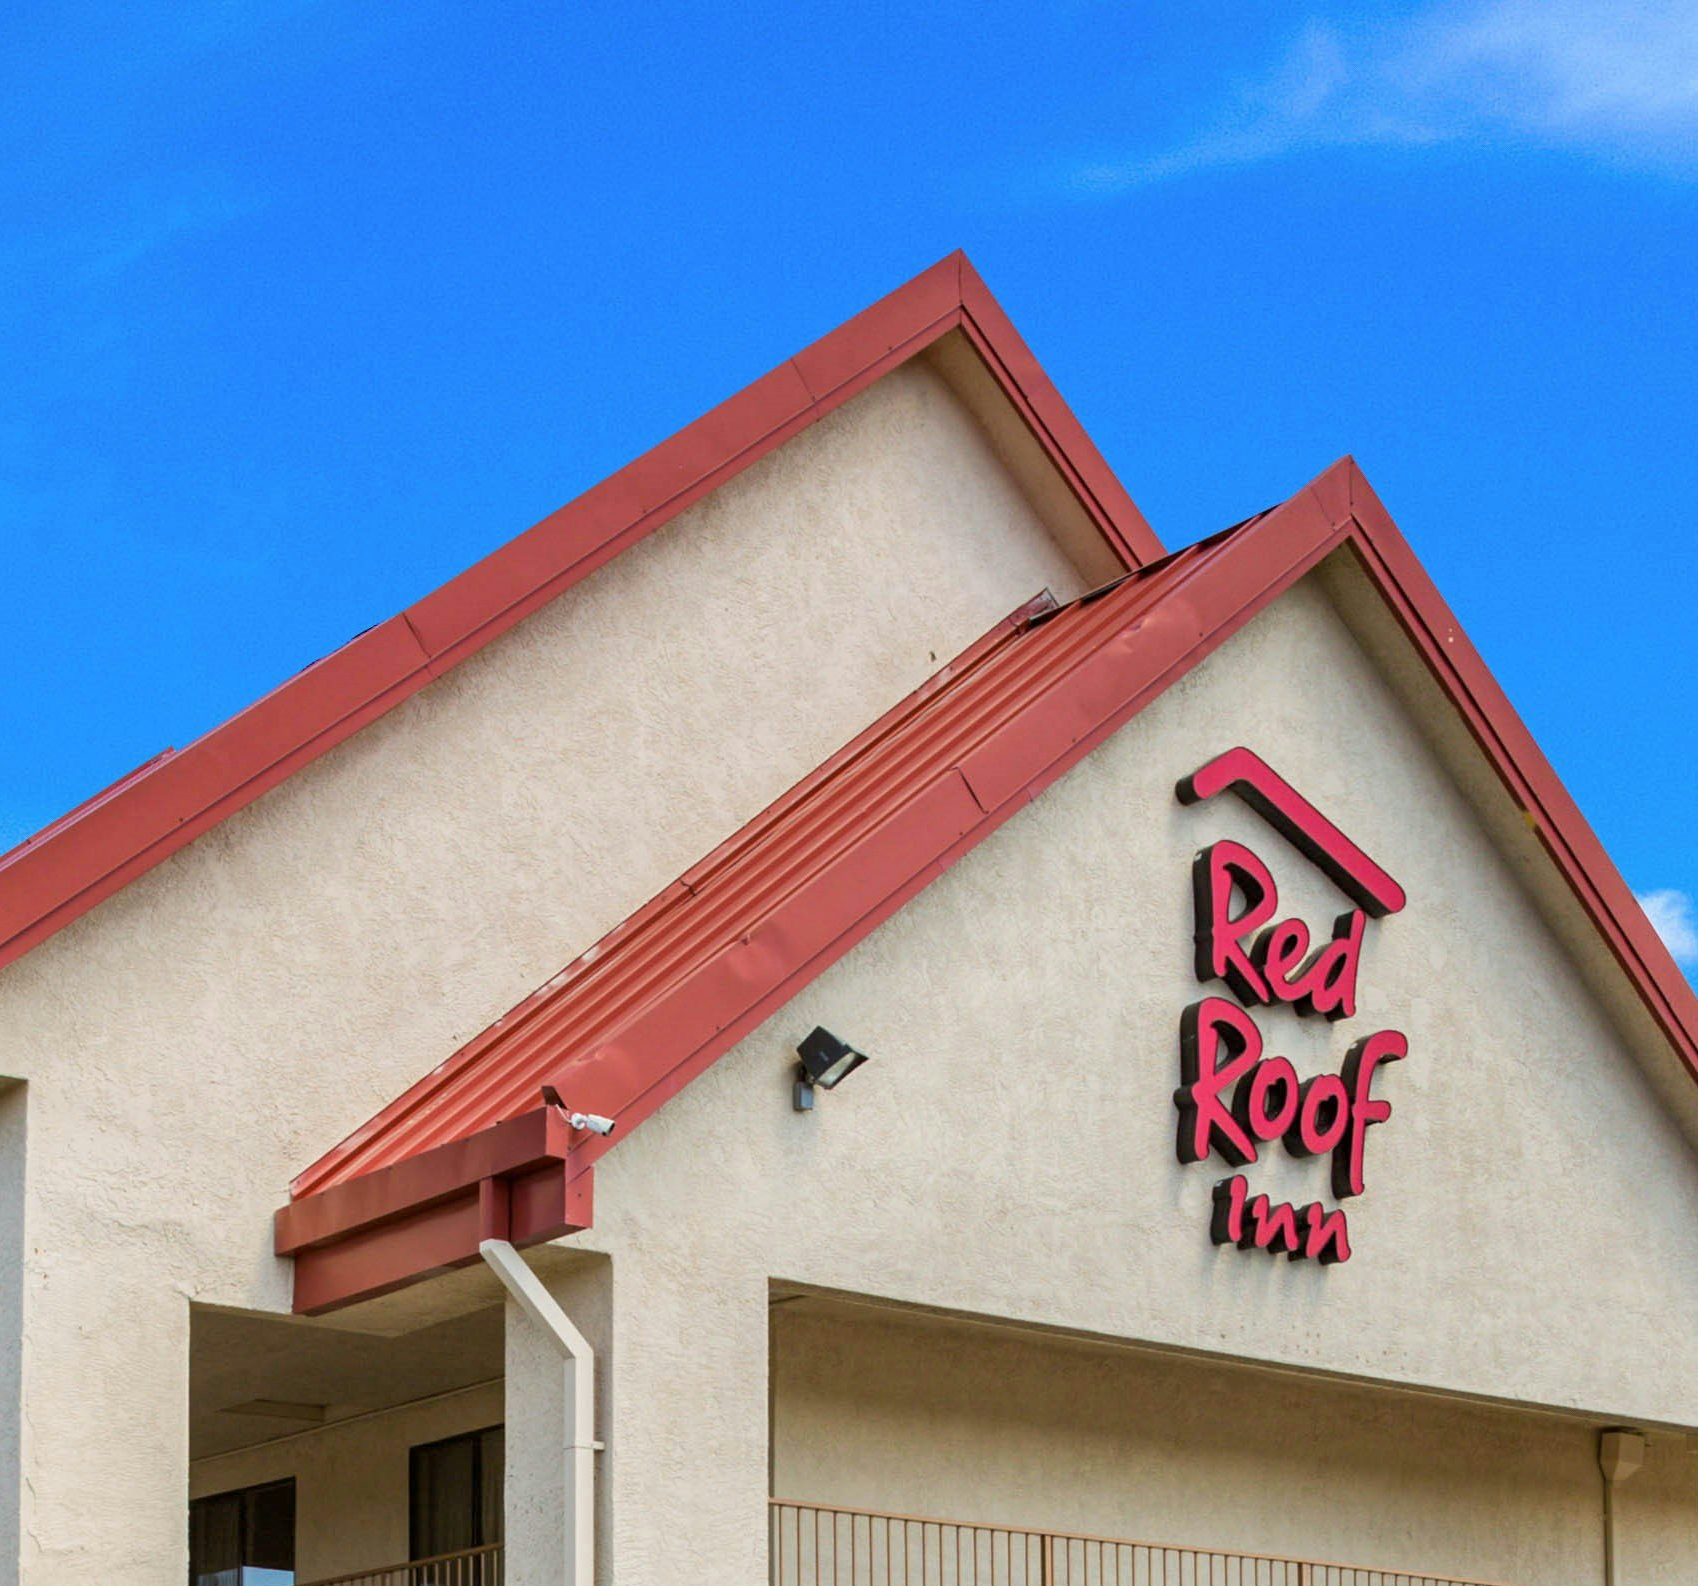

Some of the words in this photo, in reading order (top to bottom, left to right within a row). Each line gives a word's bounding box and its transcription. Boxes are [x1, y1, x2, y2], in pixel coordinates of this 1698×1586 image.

[1193, 839, 1366, 1020] Red
[1174, 996, 1408, 1198] Roof
[1211, 1174, 1352, 1264] Inn
